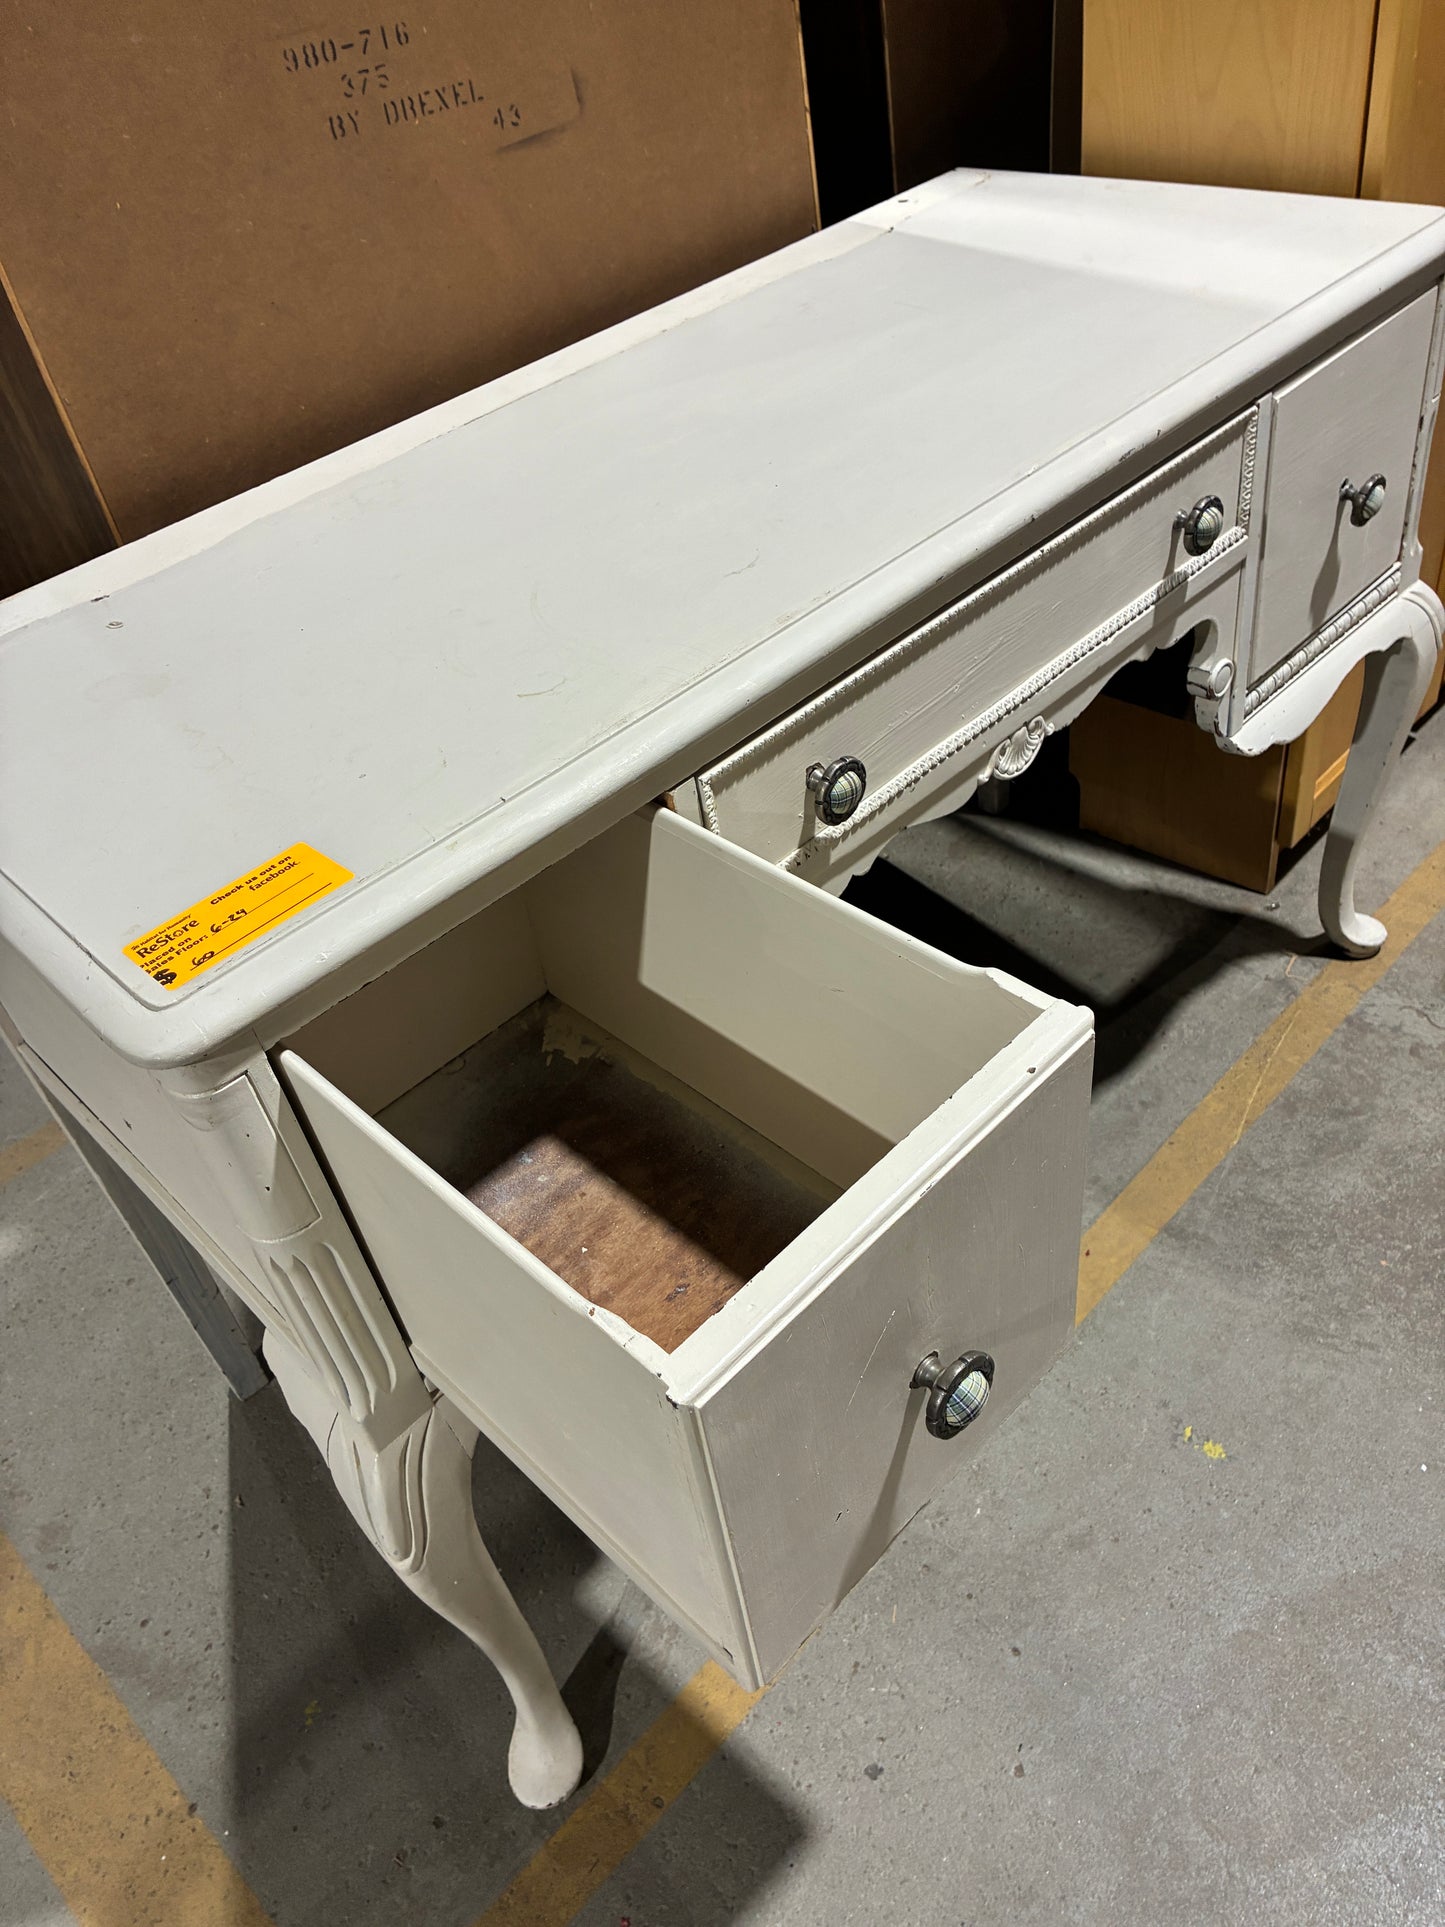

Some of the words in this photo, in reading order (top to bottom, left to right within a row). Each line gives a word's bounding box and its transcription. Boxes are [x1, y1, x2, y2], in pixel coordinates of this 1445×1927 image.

[283, 22, 409, 72] 980-716
[341, 64, 389, 98] 375
[329, 110, 359, 140] BY
[383, 79, 484, 125] DREXEL
[210, 884, 244, 905] Check
[245, 876, 258, 885] us
[259, 865, 277, 876] out
[278, 856, 291, 865] on
[249, 861, 298, 891] facebook
[136, 919, 200, 958] ReStore
[178, 937, 192, 947] on
[153, 968, 177, 986] $
